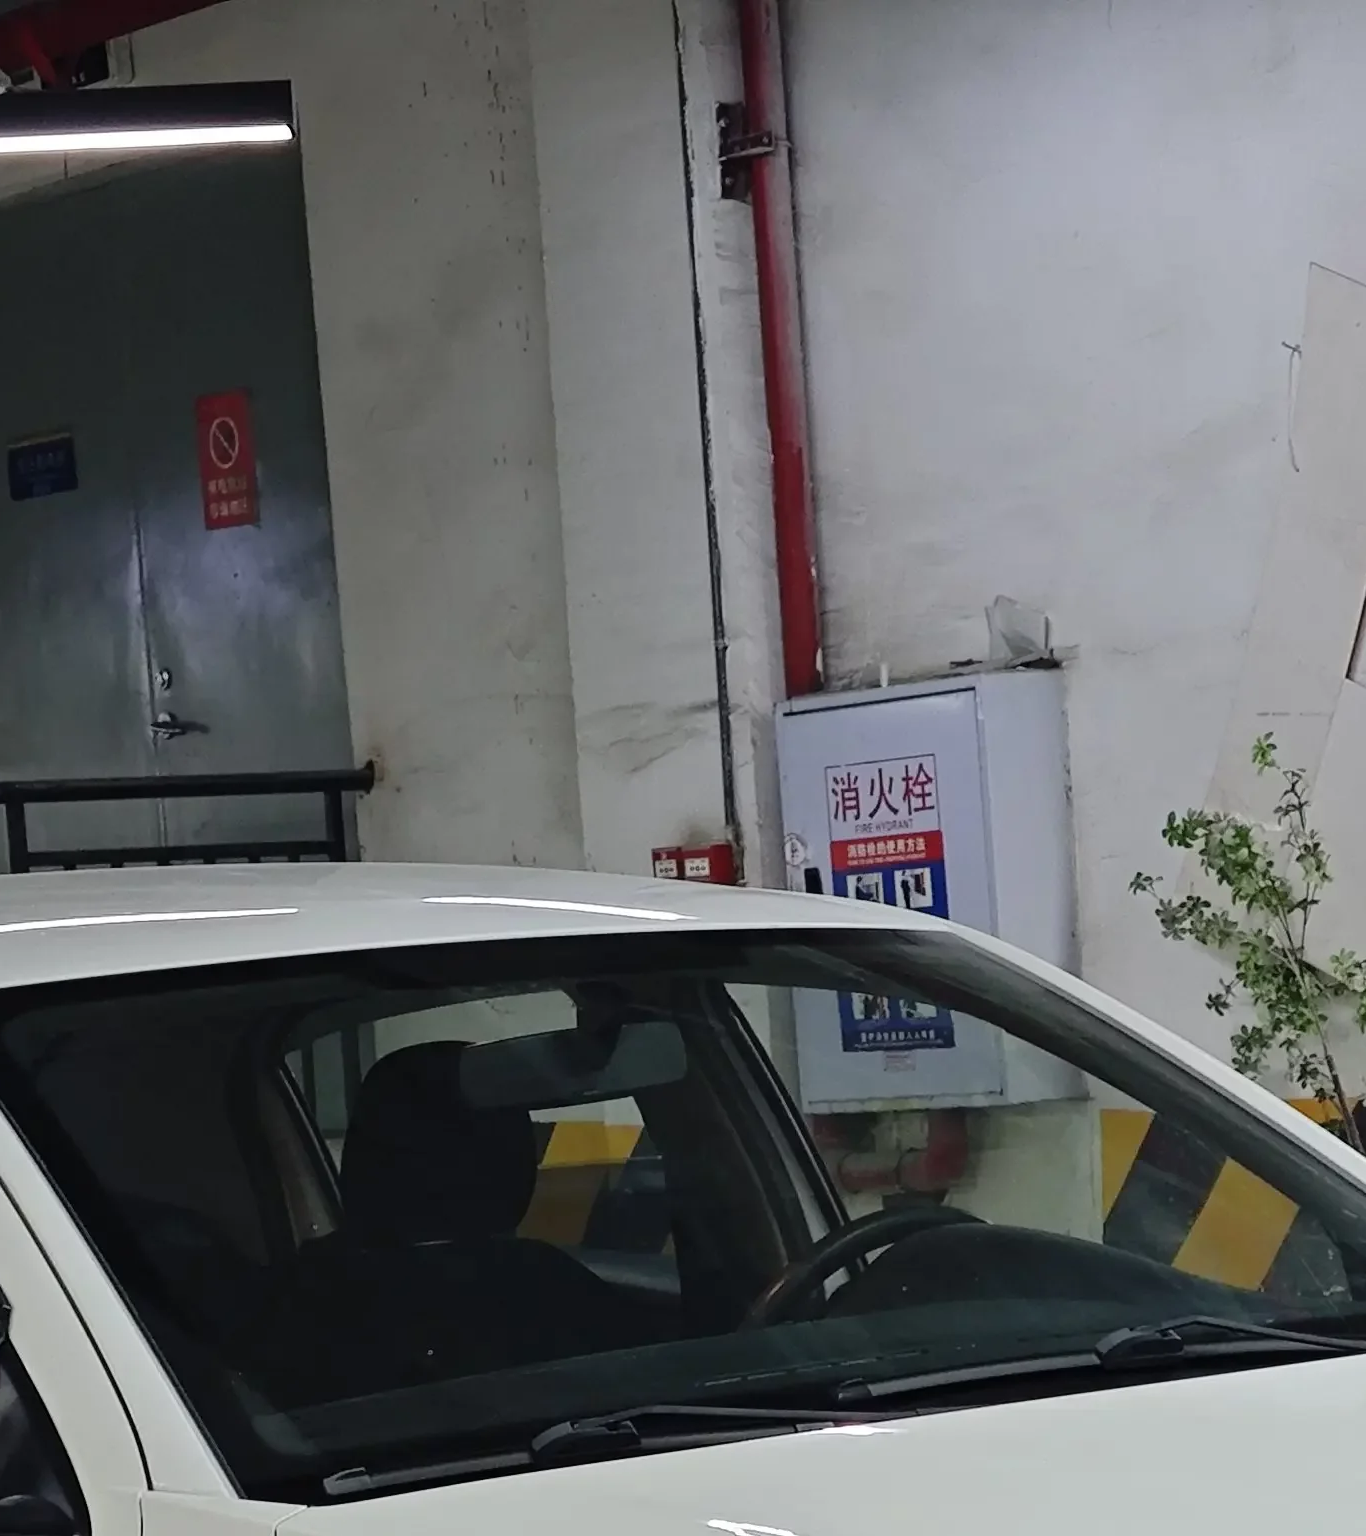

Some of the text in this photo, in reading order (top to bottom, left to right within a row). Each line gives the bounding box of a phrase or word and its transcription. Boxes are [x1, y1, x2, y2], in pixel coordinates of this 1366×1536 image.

[831, 762, 935, 822] 消火栓
[855, 818, 914, 833] FIRE HYDRANT
